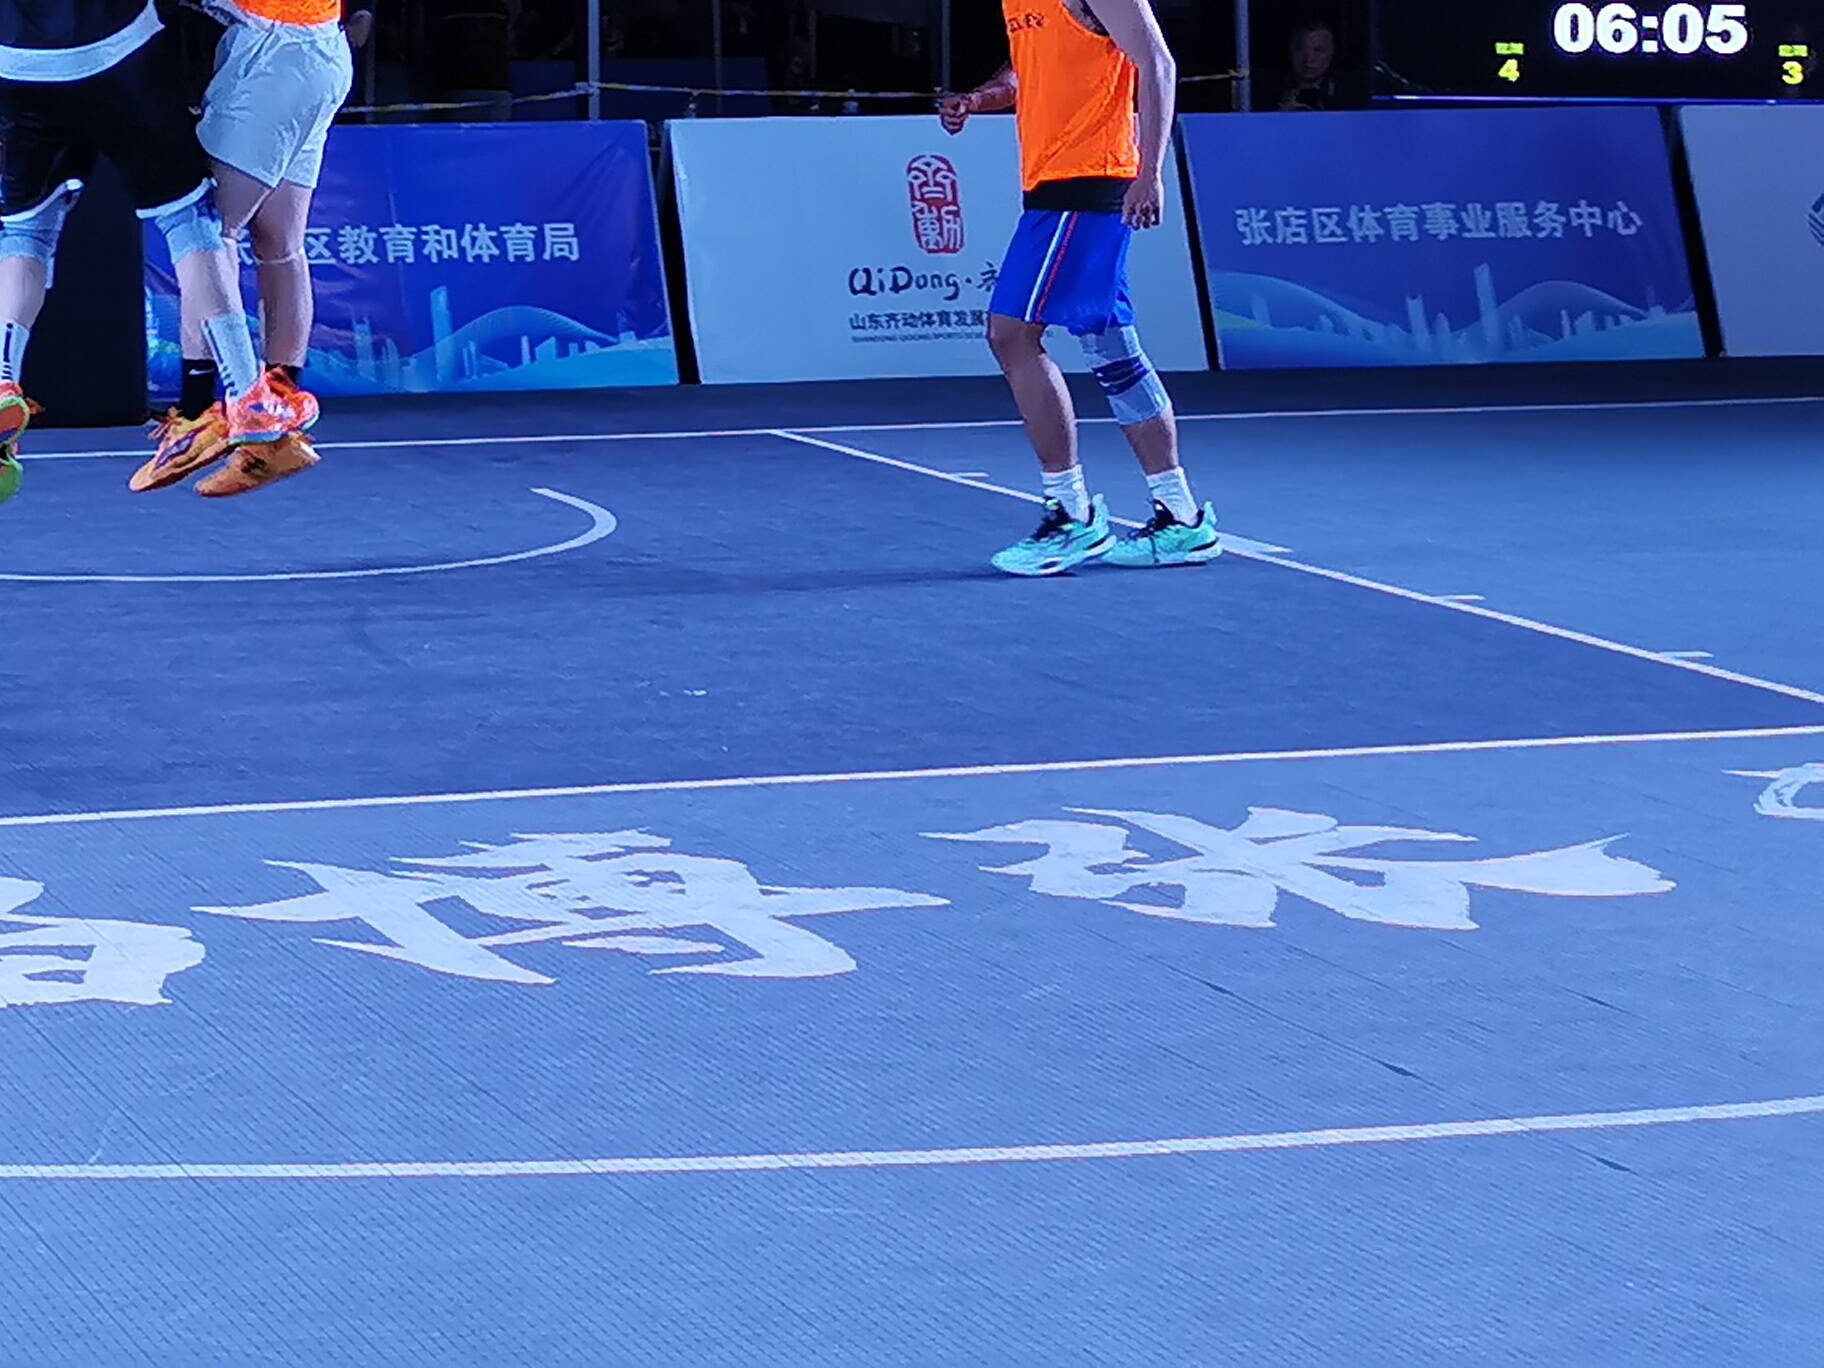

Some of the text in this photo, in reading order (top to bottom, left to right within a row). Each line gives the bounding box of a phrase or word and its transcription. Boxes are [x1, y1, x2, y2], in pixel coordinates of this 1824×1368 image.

[1552, 2, 1749, 55] 06:05
[1497, 59, 1521, 82] 4
[1781, 61, 1805, 85] 3
[1235, 199, 1644, 246] 张店区体育事业服务中心
[849, 310, 990, 330] 山东齐动体育发展
